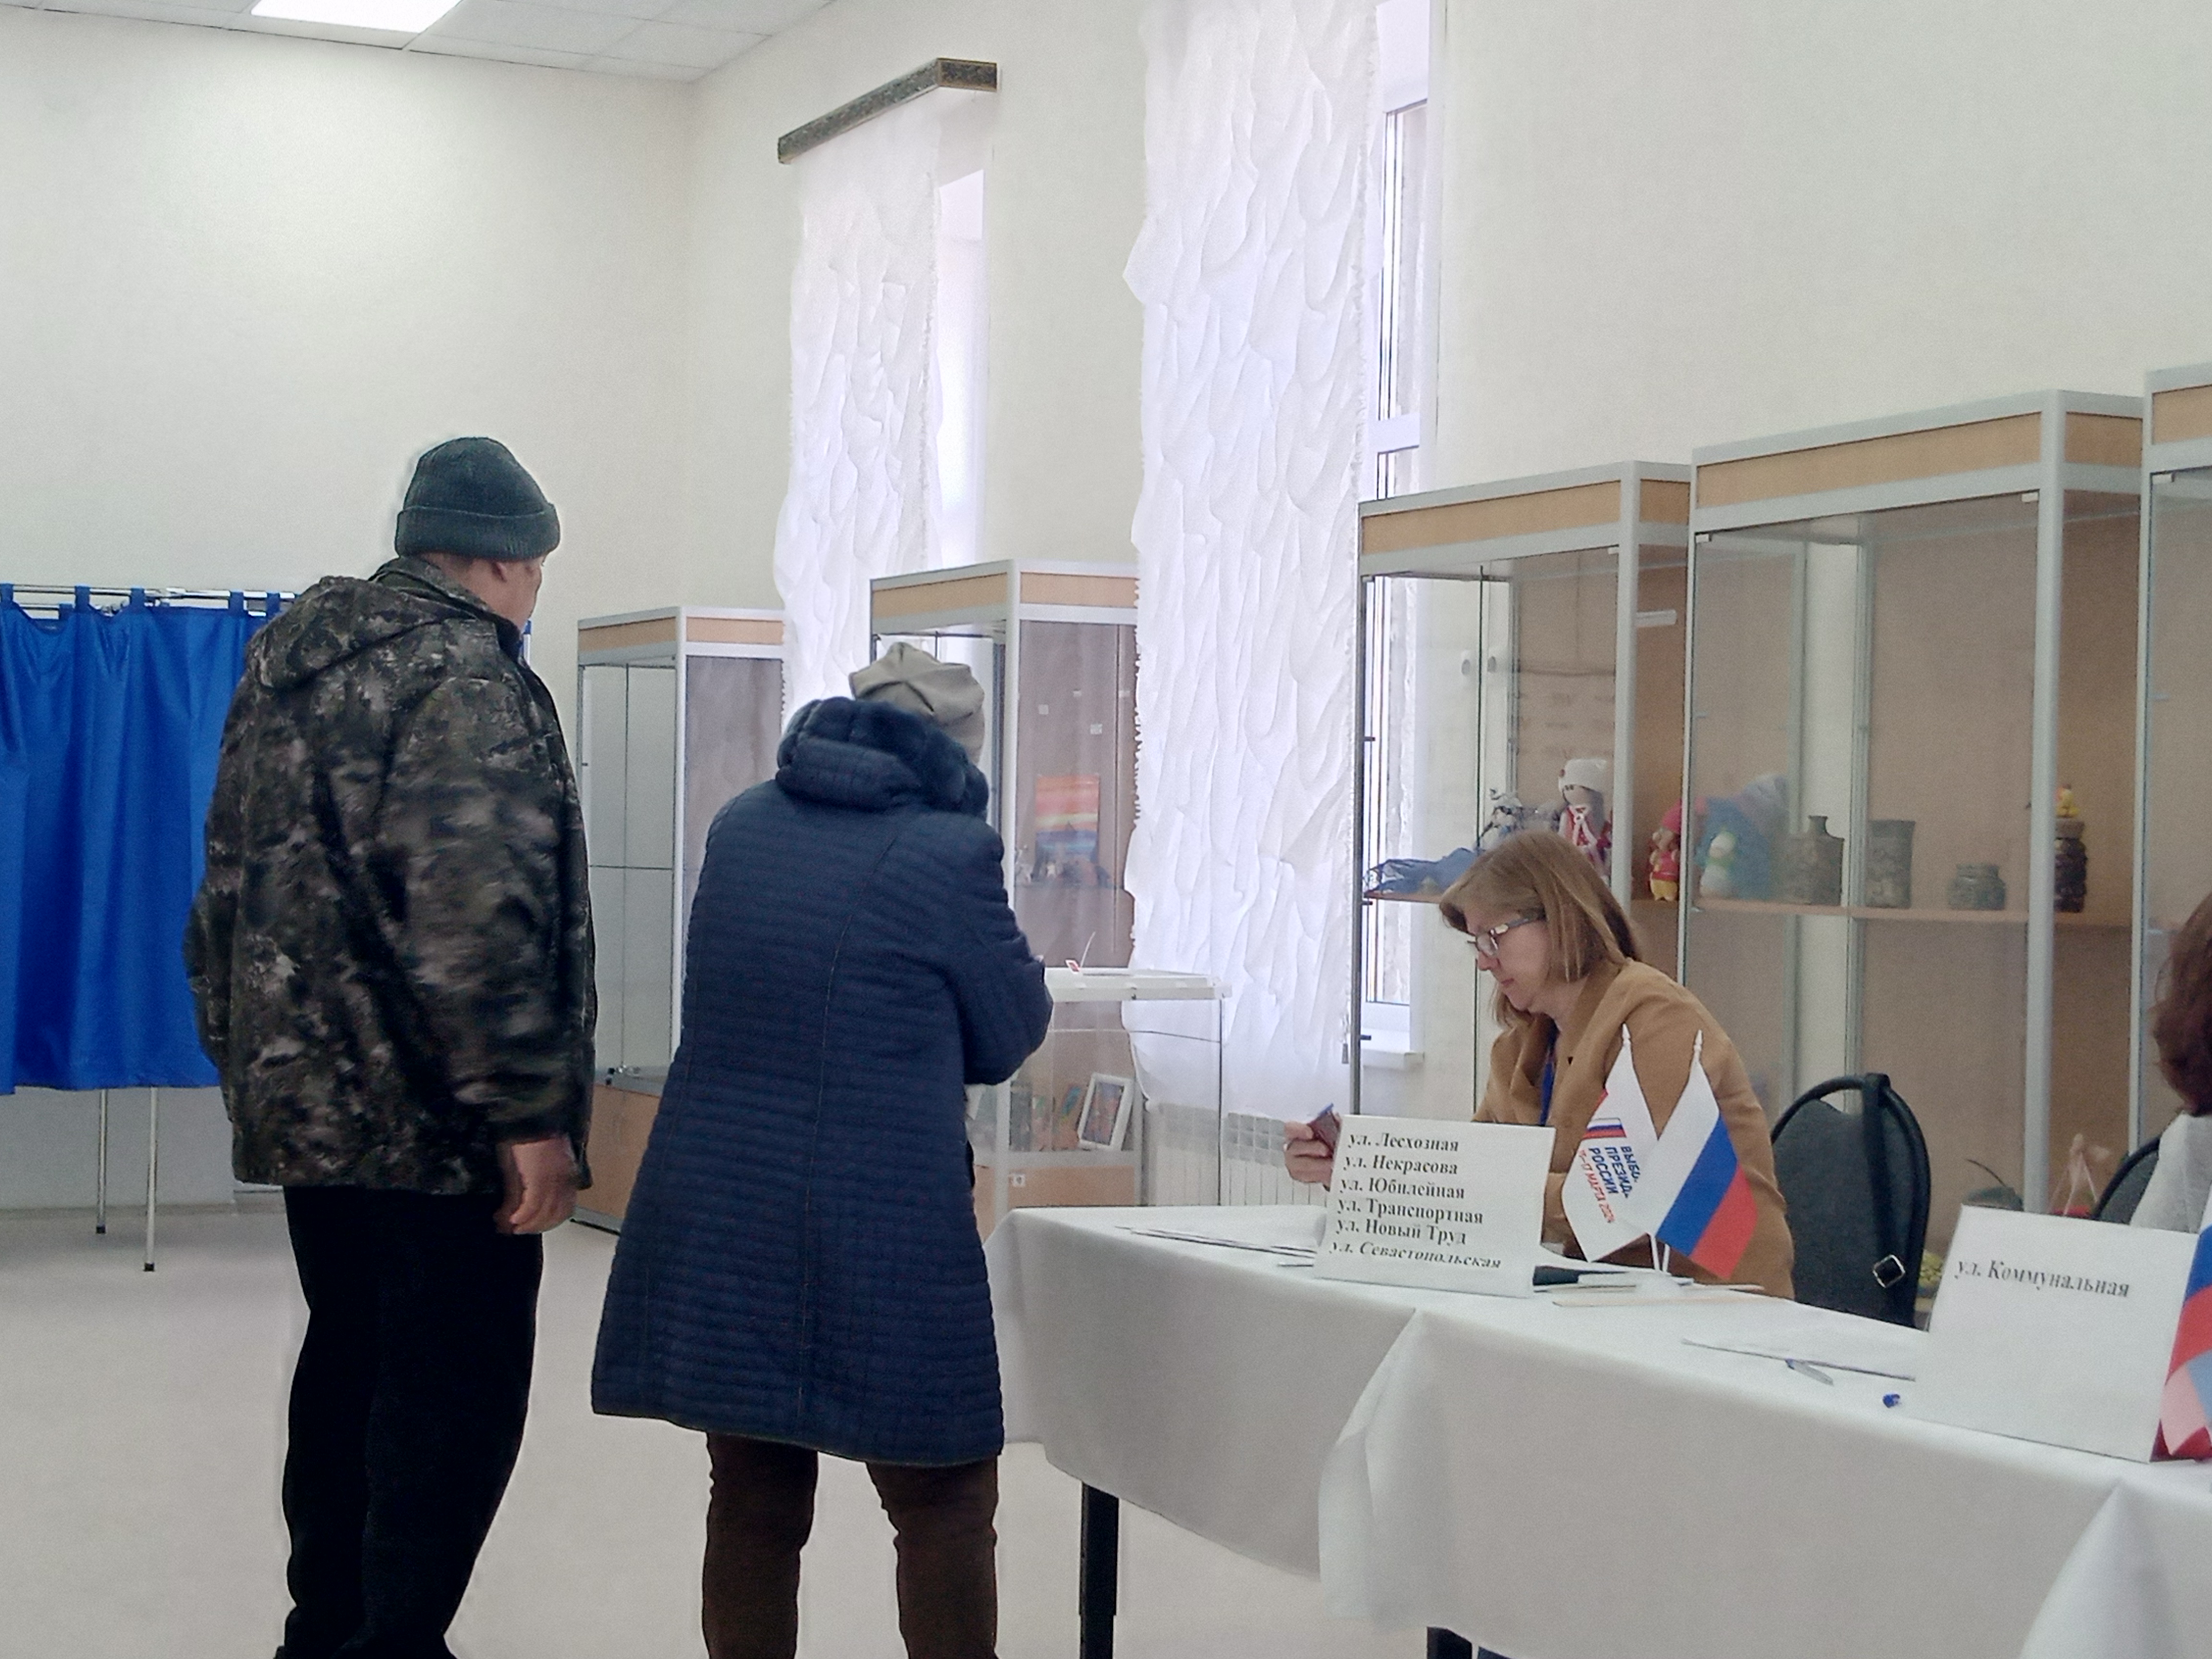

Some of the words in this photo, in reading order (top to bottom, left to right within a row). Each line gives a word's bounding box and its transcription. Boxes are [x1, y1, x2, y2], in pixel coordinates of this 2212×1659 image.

[1347, 1133, 1371, 1148] ул.
[1375, 1133, 1459, 1152] Лесхозная
[1343, 1155, 1367, 1170] ул.
[1372, 1155, 1458, 1175] Некрасова
[1589, 1148, 1618, 1193] РОССИИ
[1605, 1147, 1632, 1198] ПРЕЗИД
[1621, 1146, 1641, 1183] ВЫБО
[1340, 1177, 1363, 1192] ул.
[1369, 1177, 1465, 1199] Юбилейная
[1337, 1199, 1361, 1214] ул.
[1367, 1198, 1484, 1224] Транспортная
[1336, 1220, 1359, 1235] ул.
[1365, 1220, 1421, 1239] Новый
[1426, 1225, 1467, 1246] Труд
[1329, 1241, 1353, 1254] ул.
[1359, 1242, 1502, 1269] Севастопольская
[1954, 1260, 1981, 1279] ул.
[1988, 1260, 2129, 1297] Коммунальная
